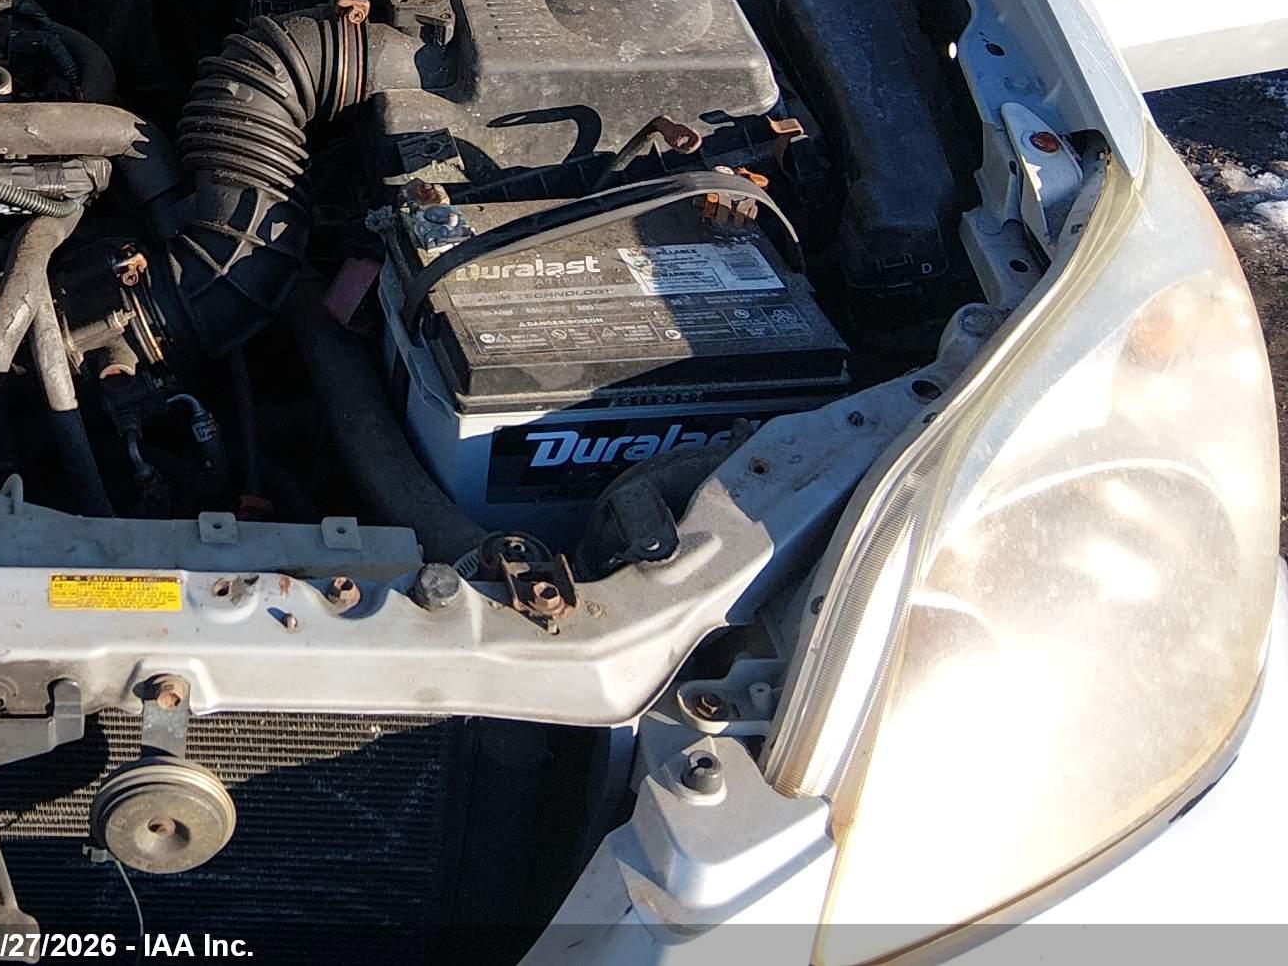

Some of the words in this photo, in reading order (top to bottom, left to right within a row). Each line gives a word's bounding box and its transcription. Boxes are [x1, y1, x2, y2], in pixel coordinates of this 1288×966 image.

[455, 255, 601, 282] Duralast
[518, 288, 614, 301] TECHNOLOGY
[525, 424, 760, 467] Duralas
